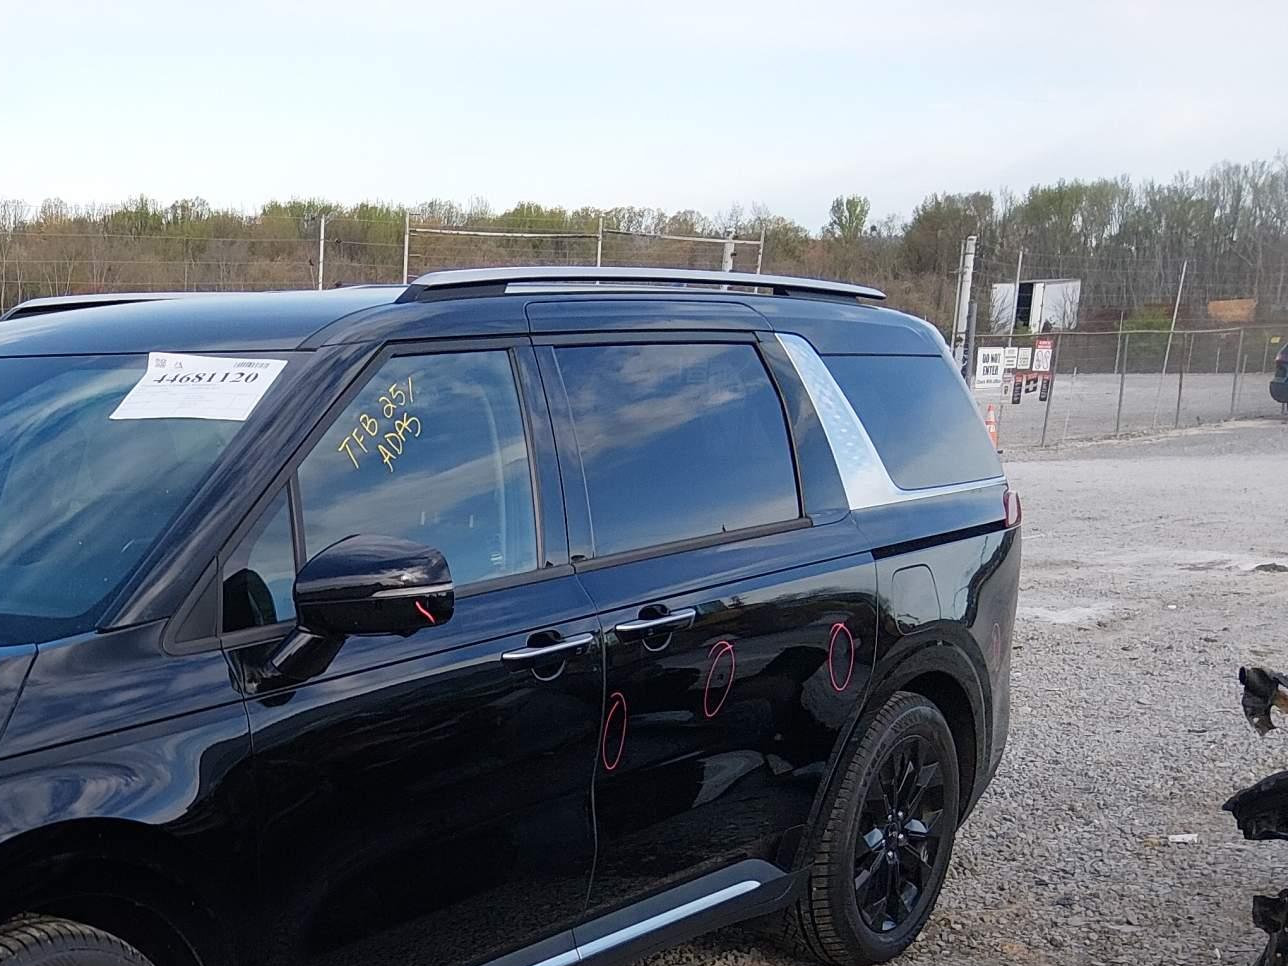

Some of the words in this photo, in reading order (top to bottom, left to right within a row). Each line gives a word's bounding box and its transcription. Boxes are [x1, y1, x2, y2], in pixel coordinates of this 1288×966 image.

[982, 353, 990, 363] DO
[991, 353, 1001, 363] NOT
[982, 365, 999, 376] ENTER
[153, 371, 259, 384] 44681120
[338, 414, 378, 469] TFB
[378, 412, 421, 473] ADAS
